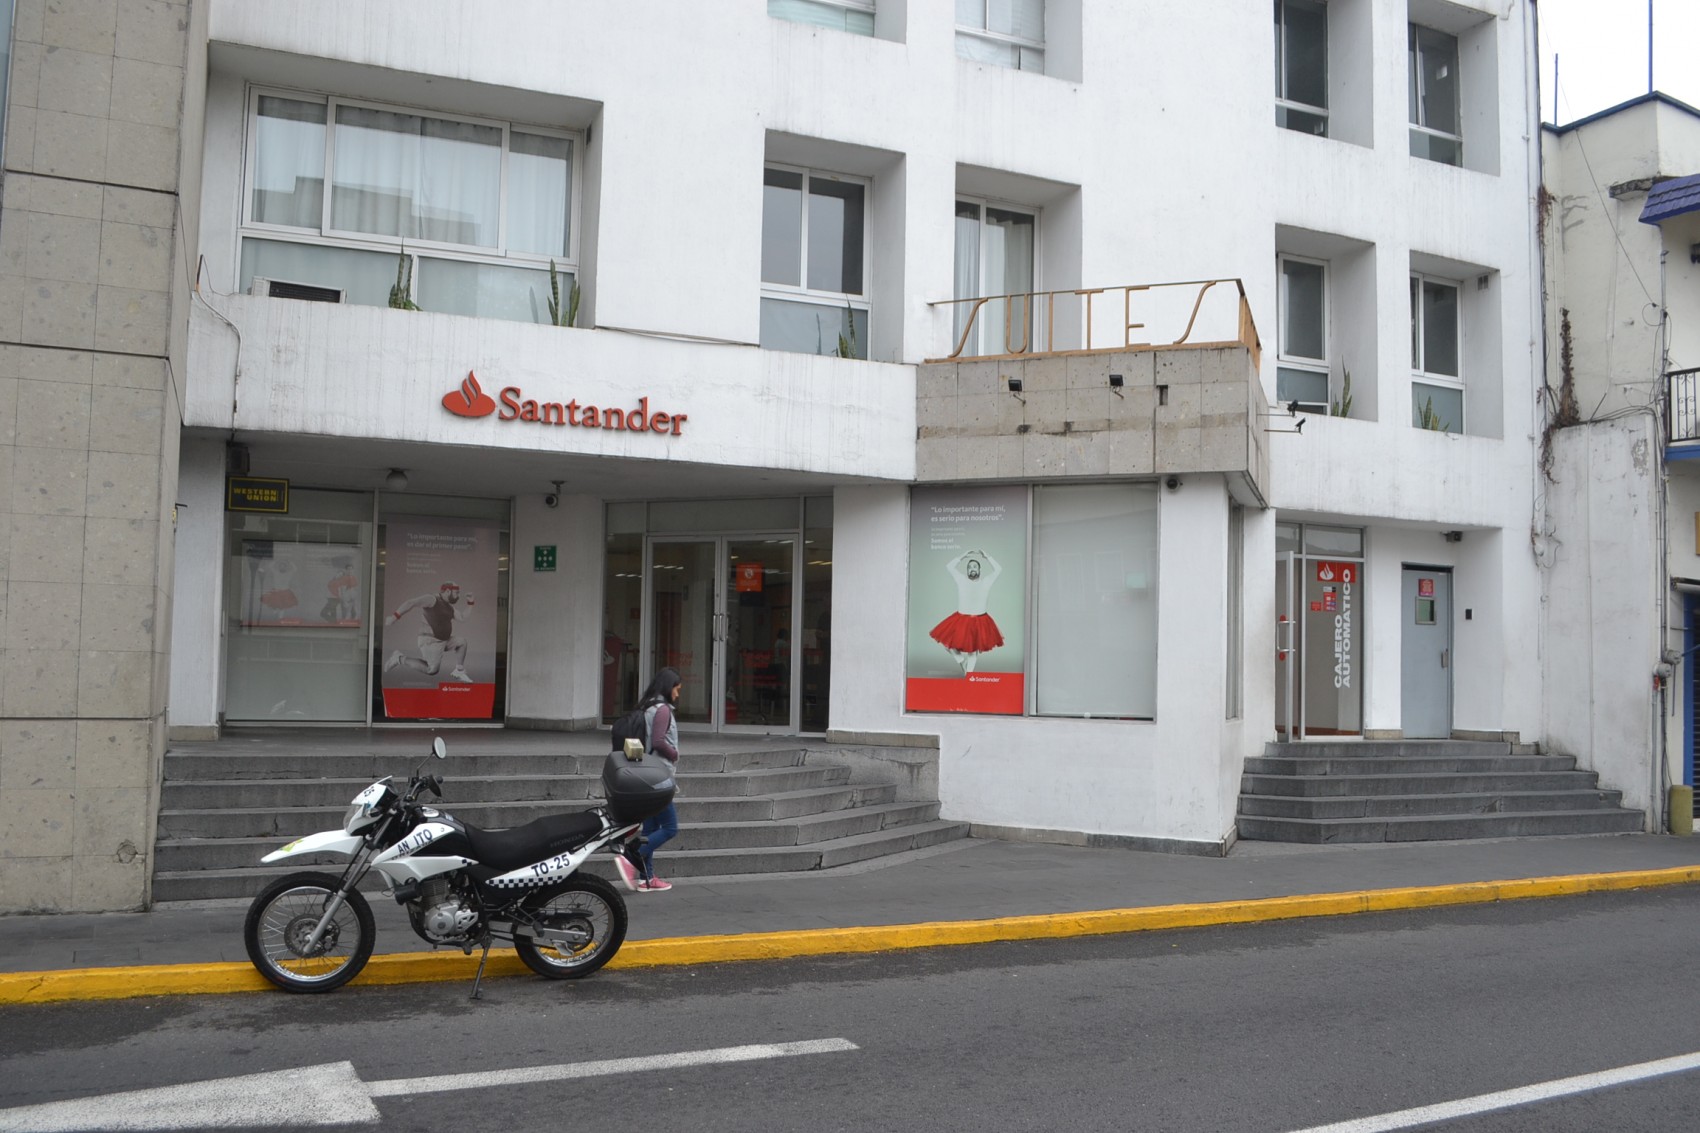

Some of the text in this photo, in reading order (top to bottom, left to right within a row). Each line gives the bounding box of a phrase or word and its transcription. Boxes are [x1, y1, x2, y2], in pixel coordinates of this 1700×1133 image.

[947, 280, 1216, 358] SUITES
[498, 386, 688, 436] Santander
[233, 487, 277, 495] WESTERN
[246, 494, 277, 502] UNION
[955, 515, 969, 523] para
[1342, 569, 1351, 688] AUTOMATICO
[1334, 614, 1342, 688] CAJERO
[550, 833, 585, 848] HONDA
[531, 853, 570, 877] TO-25
